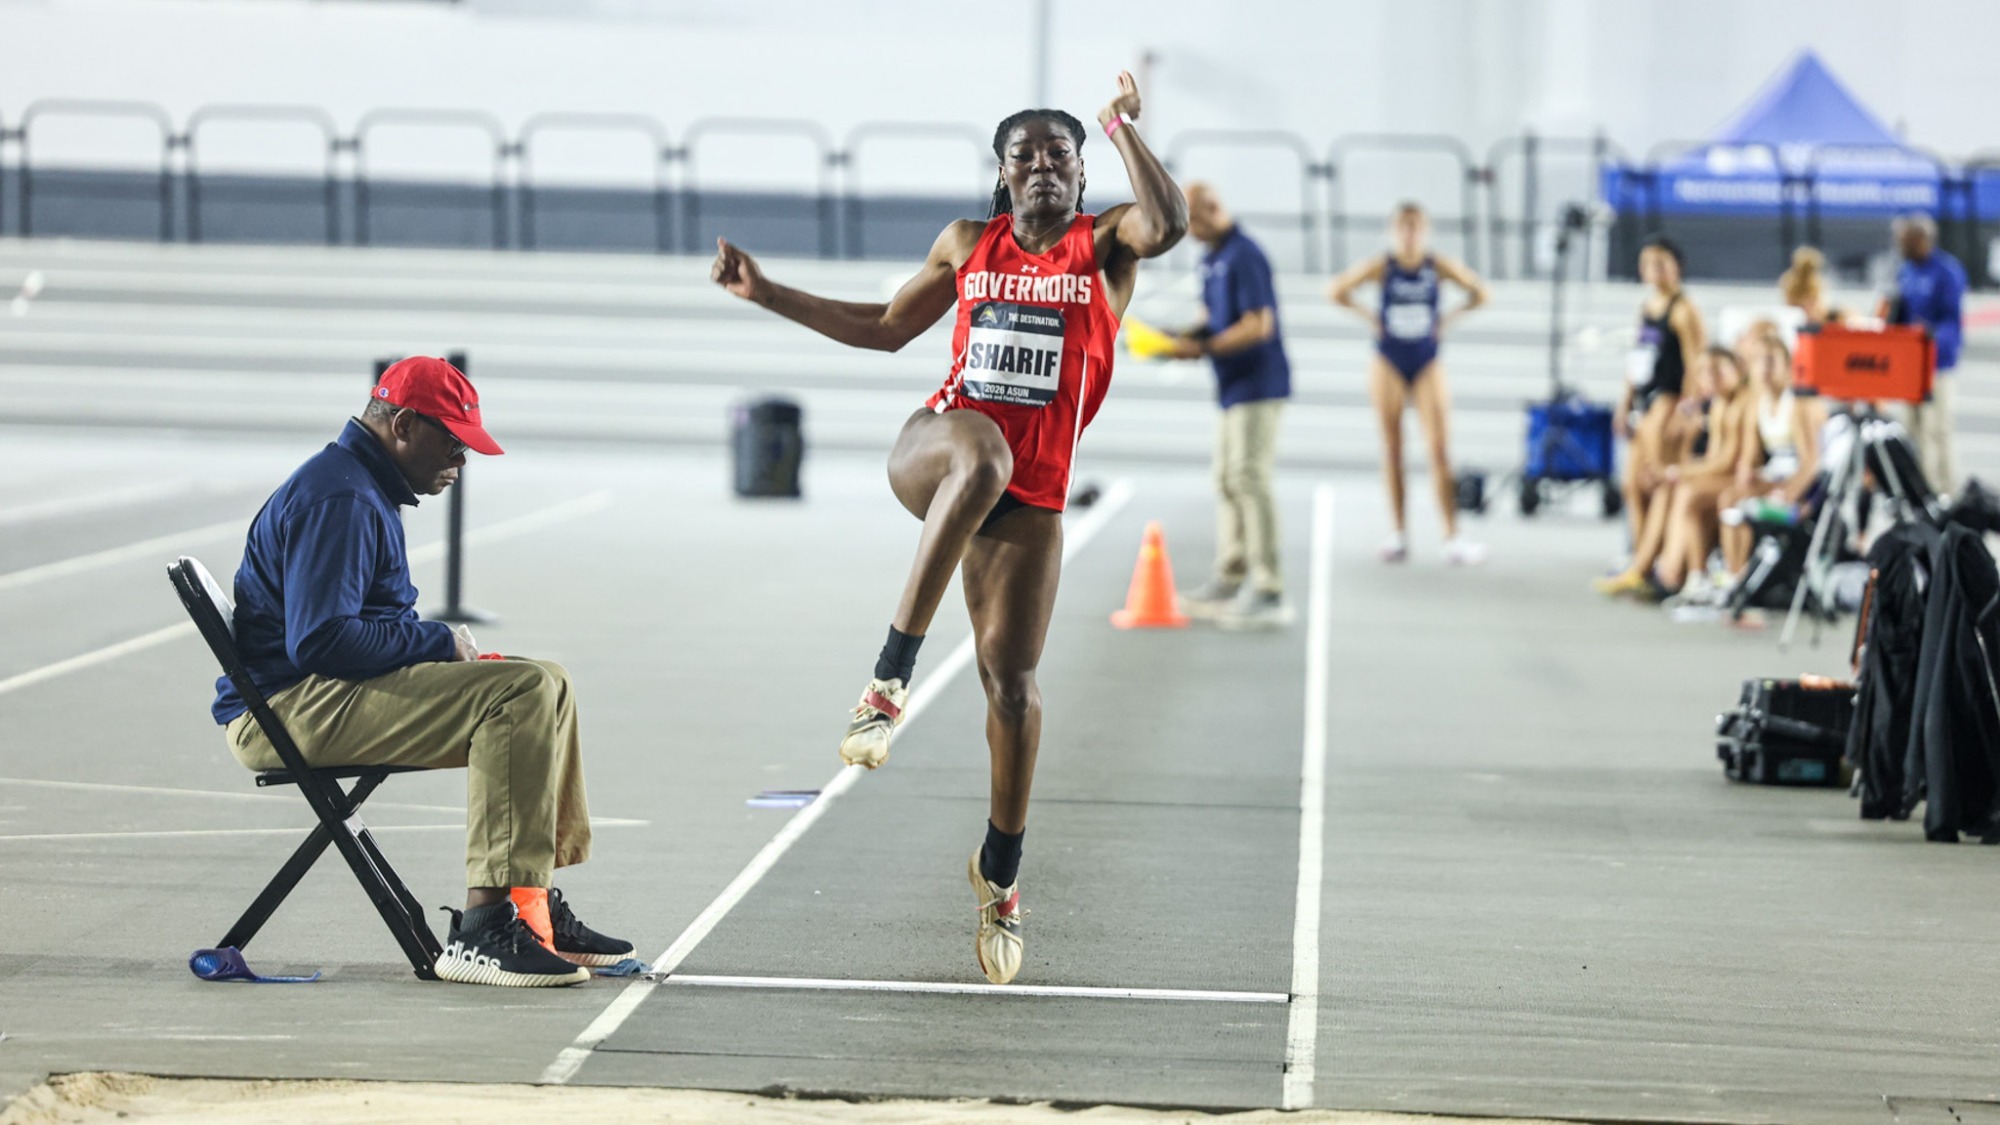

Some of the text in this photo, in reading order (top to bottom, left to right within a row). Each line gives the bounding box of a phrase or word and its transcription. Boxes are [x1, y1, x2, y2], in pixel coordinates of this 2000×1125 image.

[964, 271, 1092, 305] GOVERNORS
[1008, 312, 1019, 322] THE
[969, 342, 1058, 377] SHARIF
[984, 383, 1030, 398] 2026 ASUN
[445, 940, 502, 970] didas
